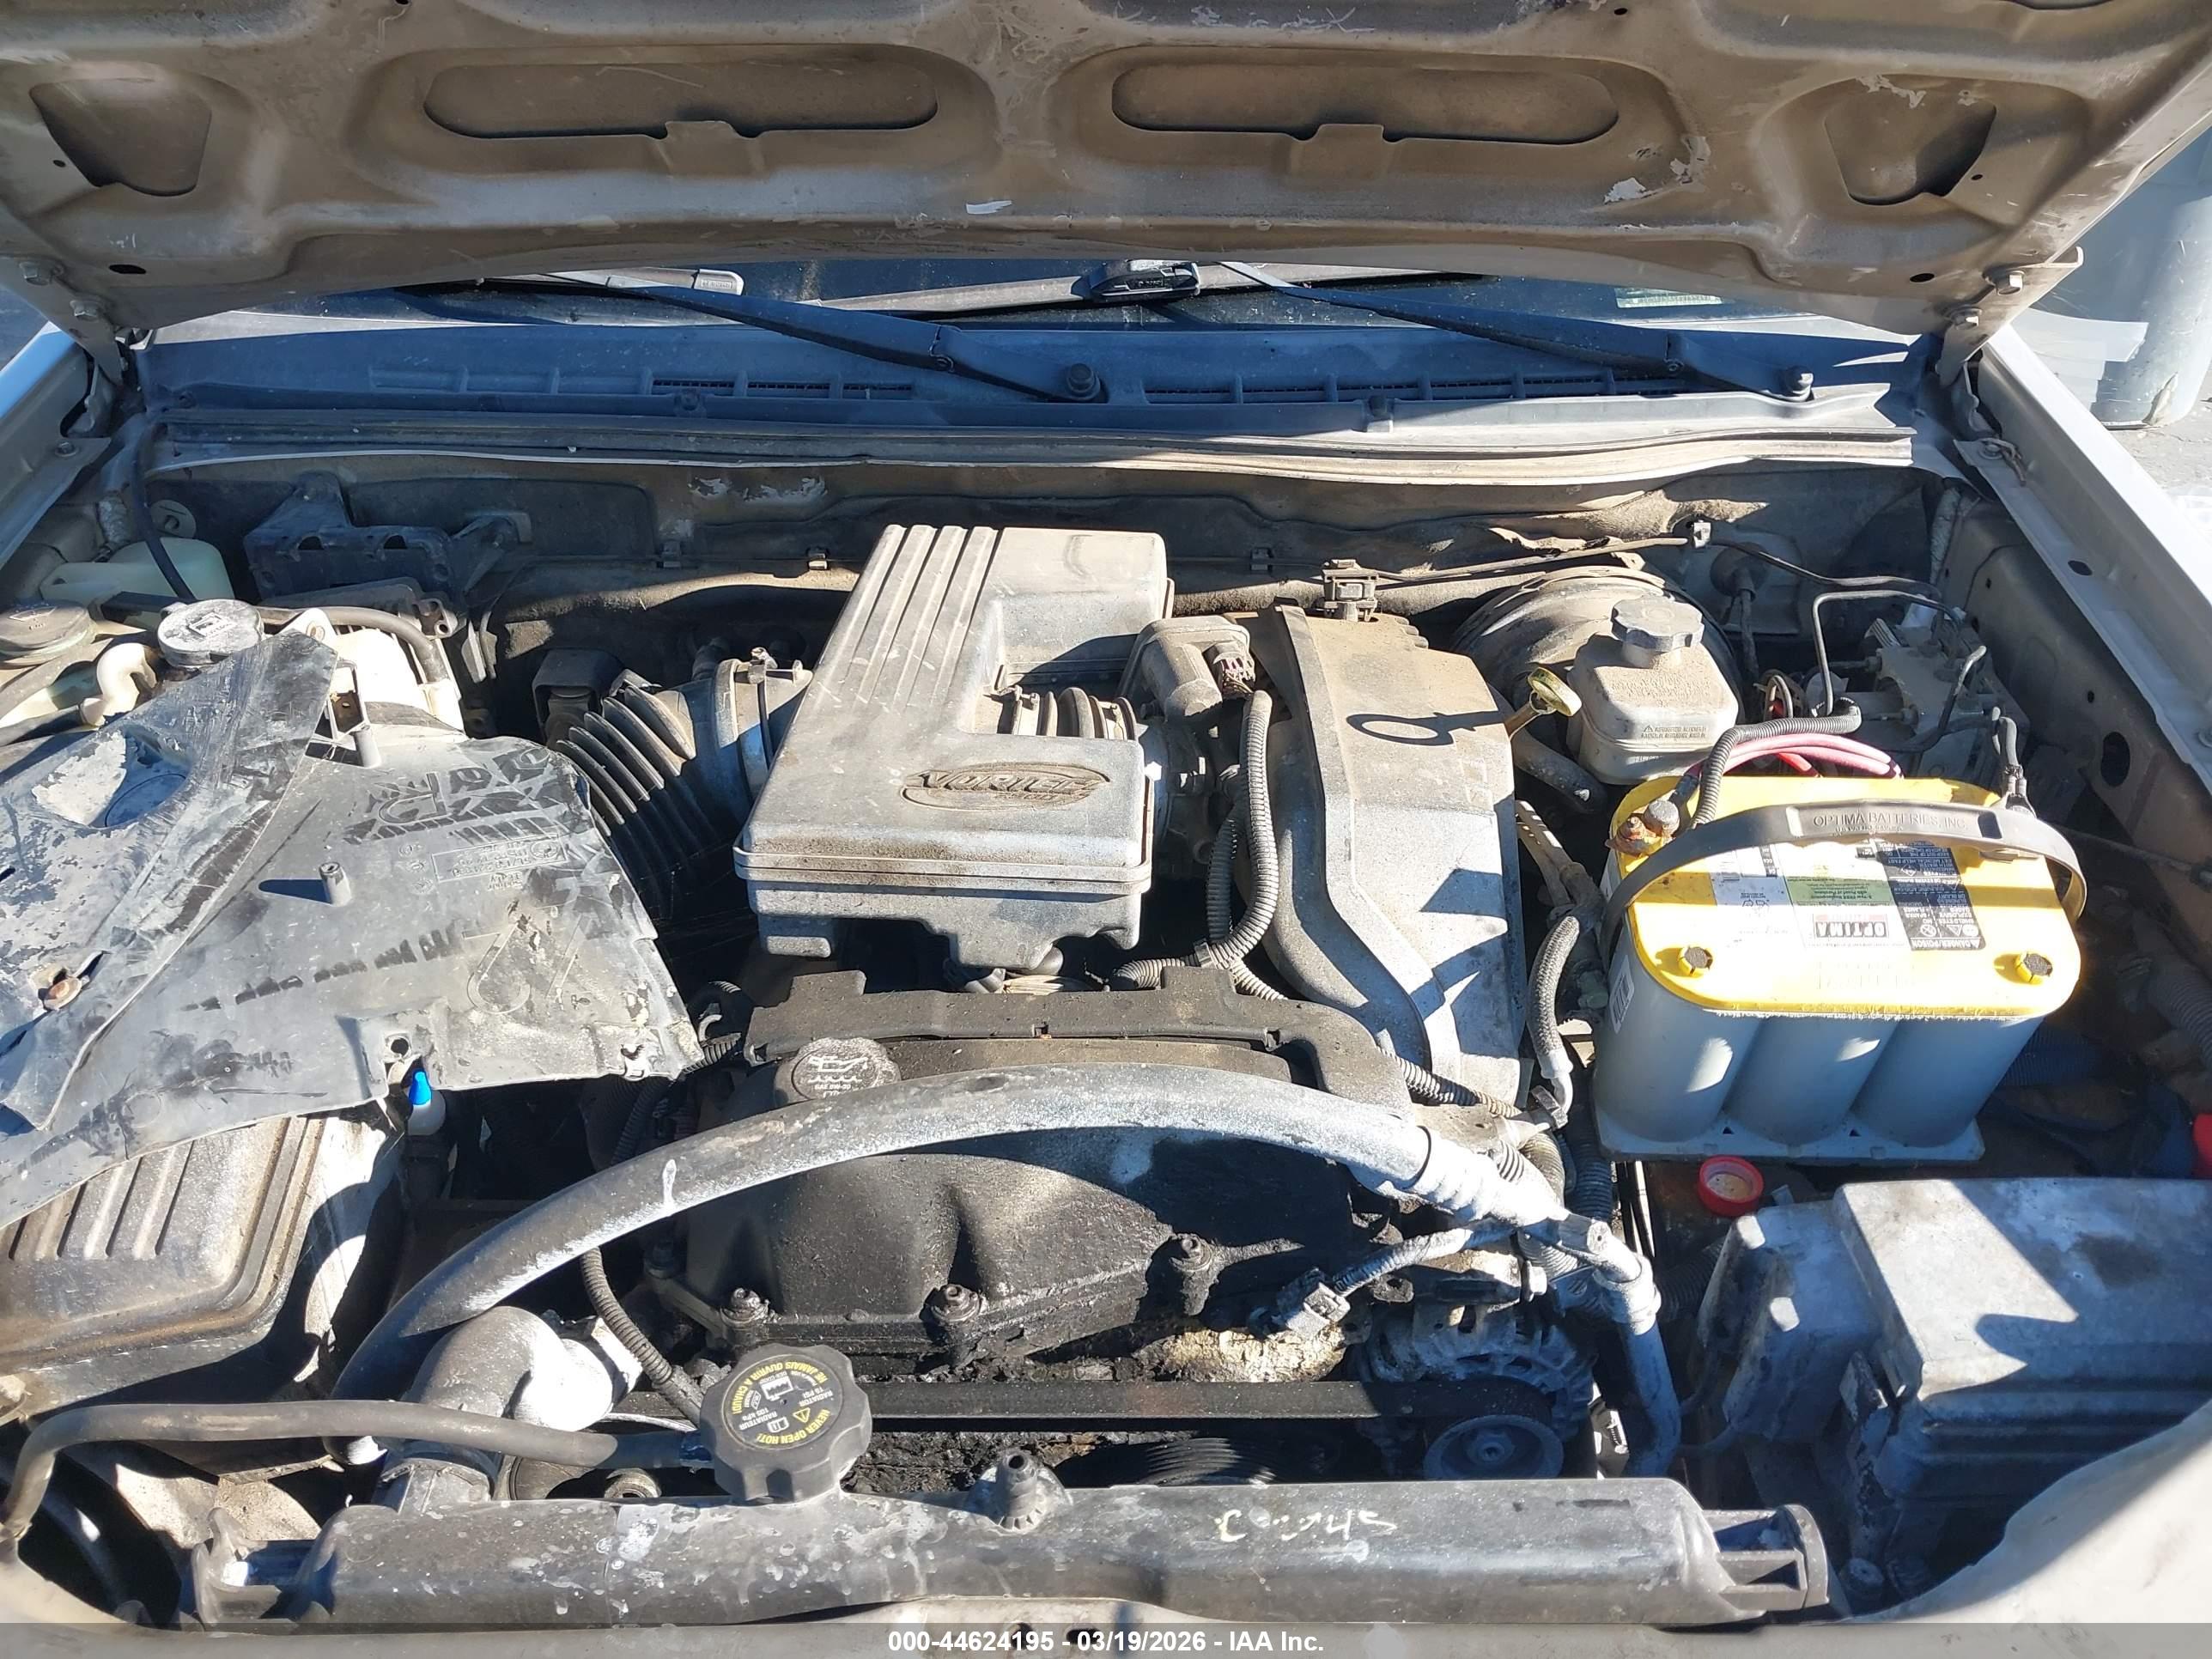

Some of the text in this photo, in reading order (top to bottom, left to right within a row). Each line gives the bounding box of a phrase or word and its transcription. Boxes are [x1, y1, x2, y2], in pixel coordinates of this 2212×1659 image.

[1813, 811, 1969, 830] OPTIMA BATTERIES, INC.
[1816, 921, 1887, 938] OPTIMA
[750, 1363, 784, 1381] OUVRIR
[784, 1362, 818, 1376] JAMAIS
[814, 1371, 829, 1384] NE
[732, 1386, 749, 1414] CHAUD!
[798, 1389, 834, 1407] RADIATOR
[802, 1389, 815, 1399] PSI
[738, 1411, 778, 1431] RADIATEUR
[756, 1408, 831, 1444] NEVER OPEN HOT!
